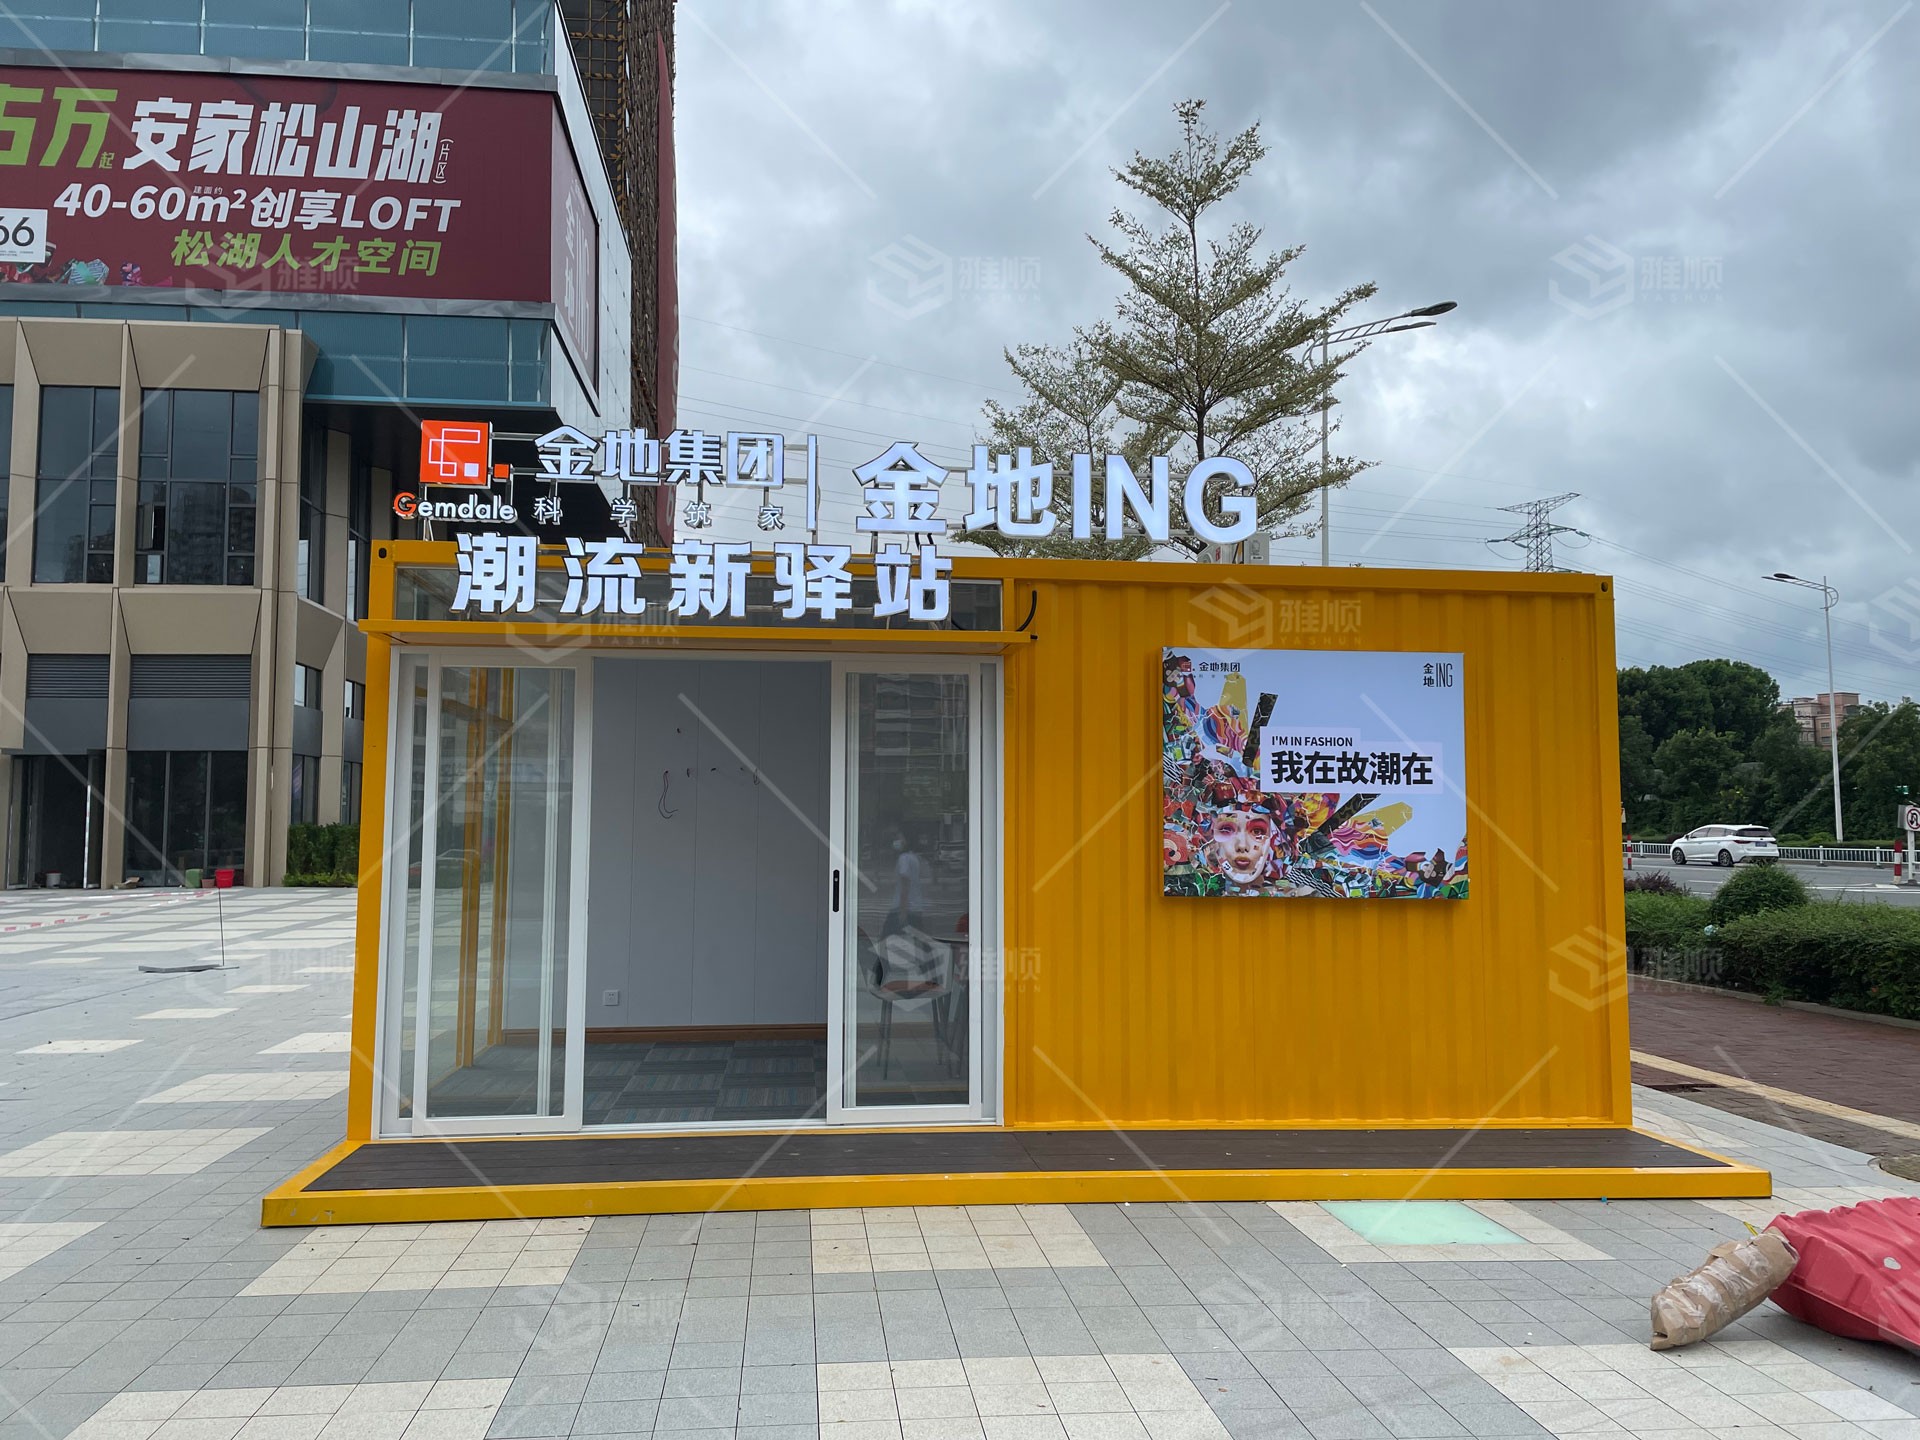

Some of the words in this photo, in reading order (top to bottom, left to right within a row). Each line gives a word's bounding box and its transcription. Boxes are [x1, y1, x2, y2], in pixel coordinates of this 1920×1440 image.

[122, 96, 443, 184] 安家松山湖
[170, 228, 442, 277] 松湖人才空间
[534, 424, 786, 489] 金地集团
[393, 492, 518, 523] Gemdale
[449, 532, 954, 622] 潮流新驿站
[1271, 735, 1288, 746] I'M
[1290, 736, 1302, 747] IN
[1304, 736, 1353, 747] FASHION
[1270, 750, 1433, 786] 我在故潮在
